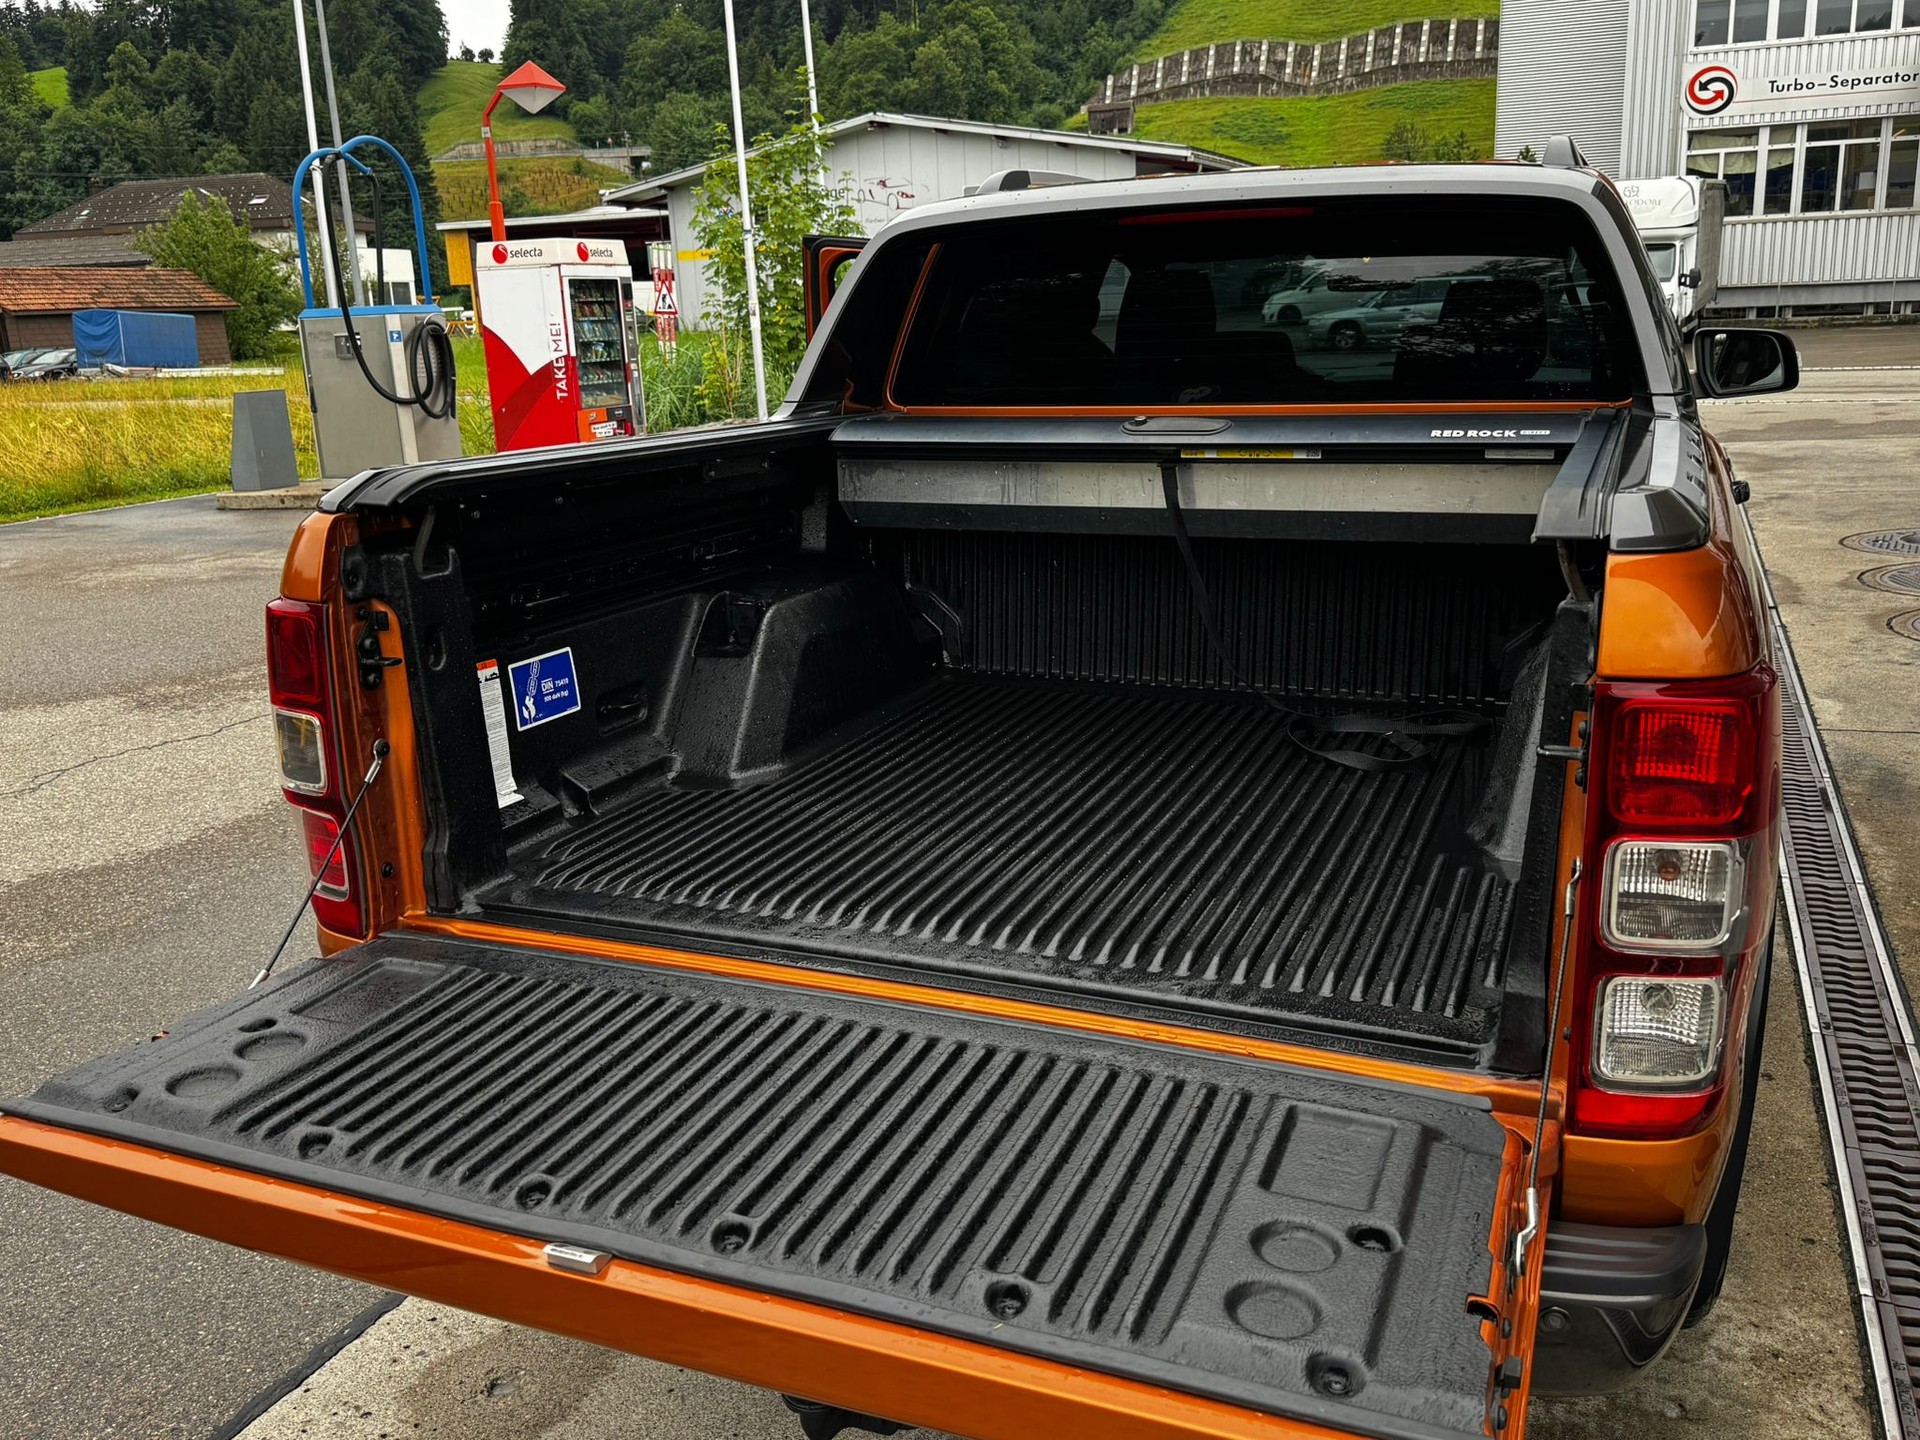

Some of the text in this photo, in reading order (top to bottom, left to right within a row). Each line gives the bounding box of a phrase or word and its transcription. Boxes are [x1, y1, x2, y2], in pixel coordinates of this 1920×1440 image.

[1768, 72, 1919, 93] Turbo-Separator
[509, 247, 543, 258] selecta
[589, 248, 613, 258] selecta
[549, 322, 569, 400] TAKE ME!
